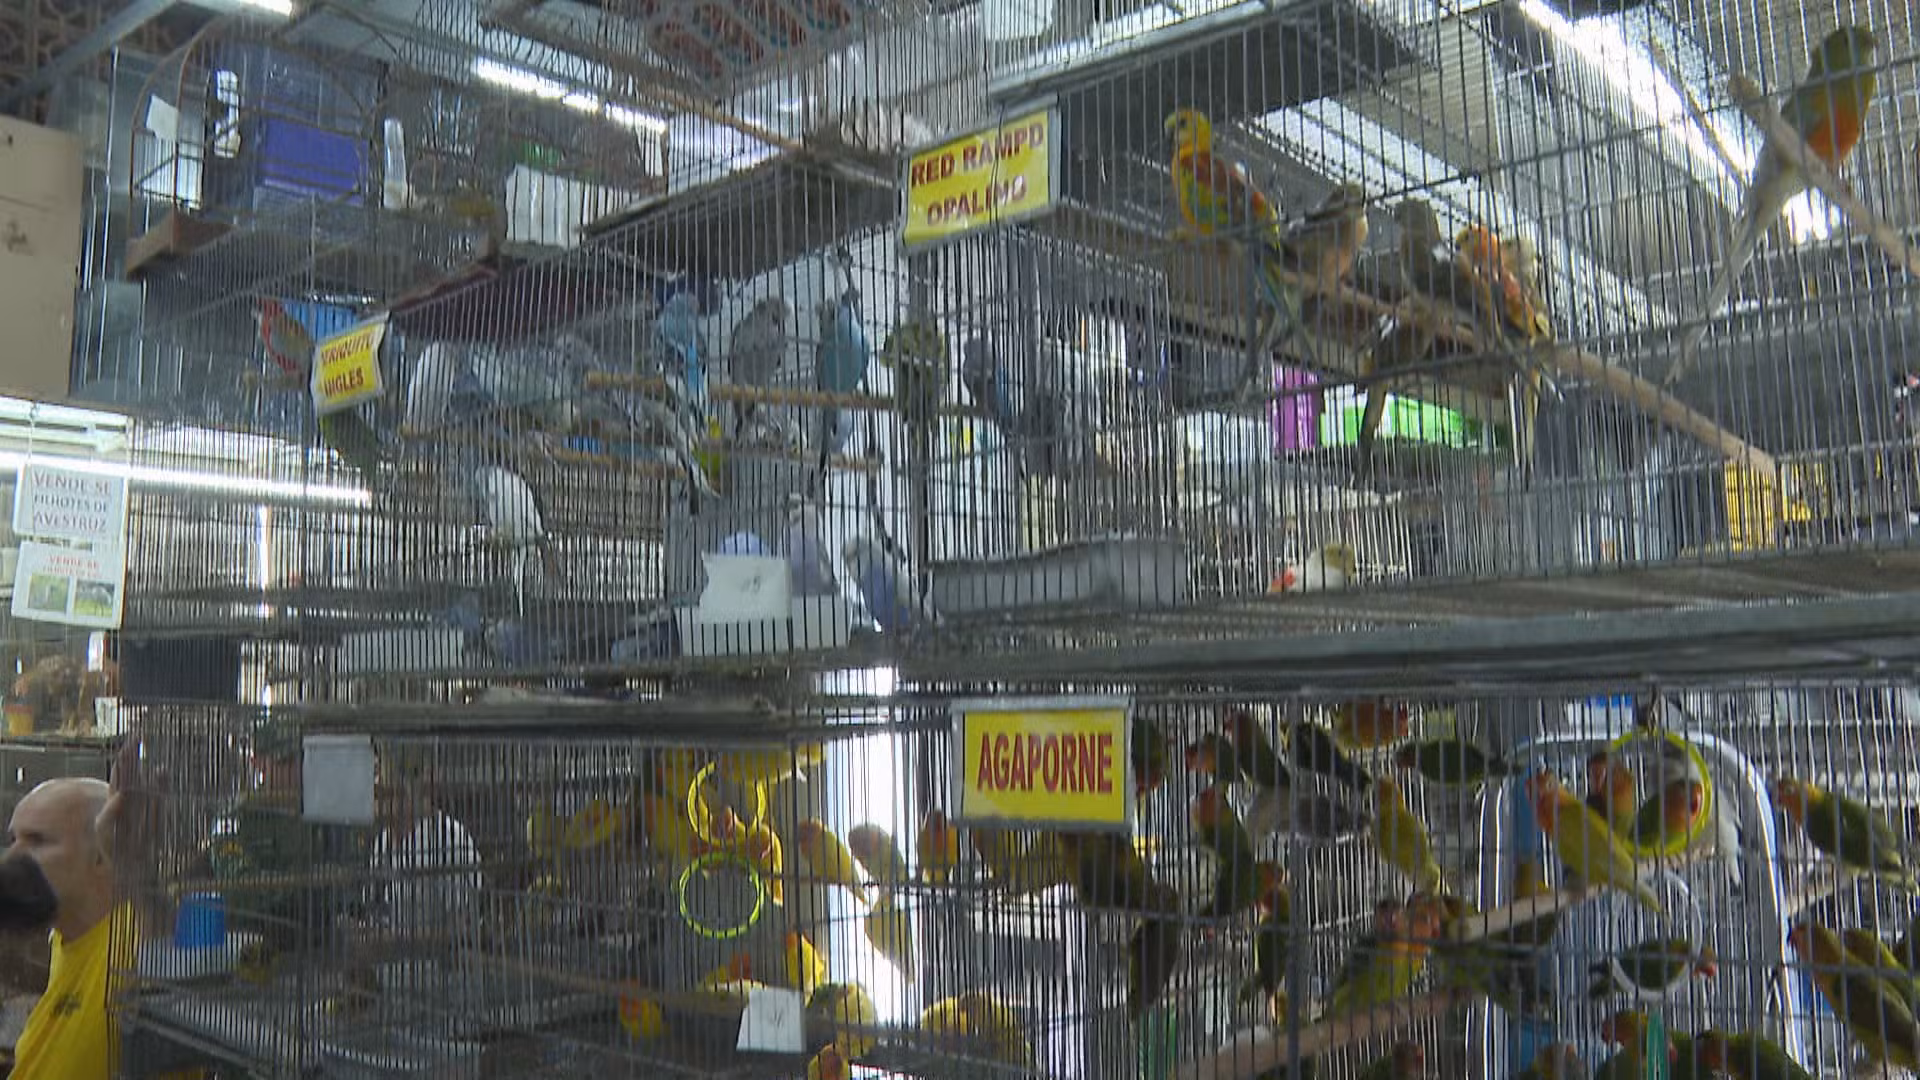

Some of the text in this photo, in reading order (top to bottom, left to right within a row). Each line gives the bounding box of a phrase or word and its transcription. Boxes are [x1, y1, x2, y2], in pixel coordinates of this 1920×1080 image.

[911, 123, 1044, 188] RED RAMPD
[927, 176, 1027, 226] OPALINO
[34, 511, 107, 532] AVESTRUZ
[977, 731, 1113, 794] AGAPORNE
